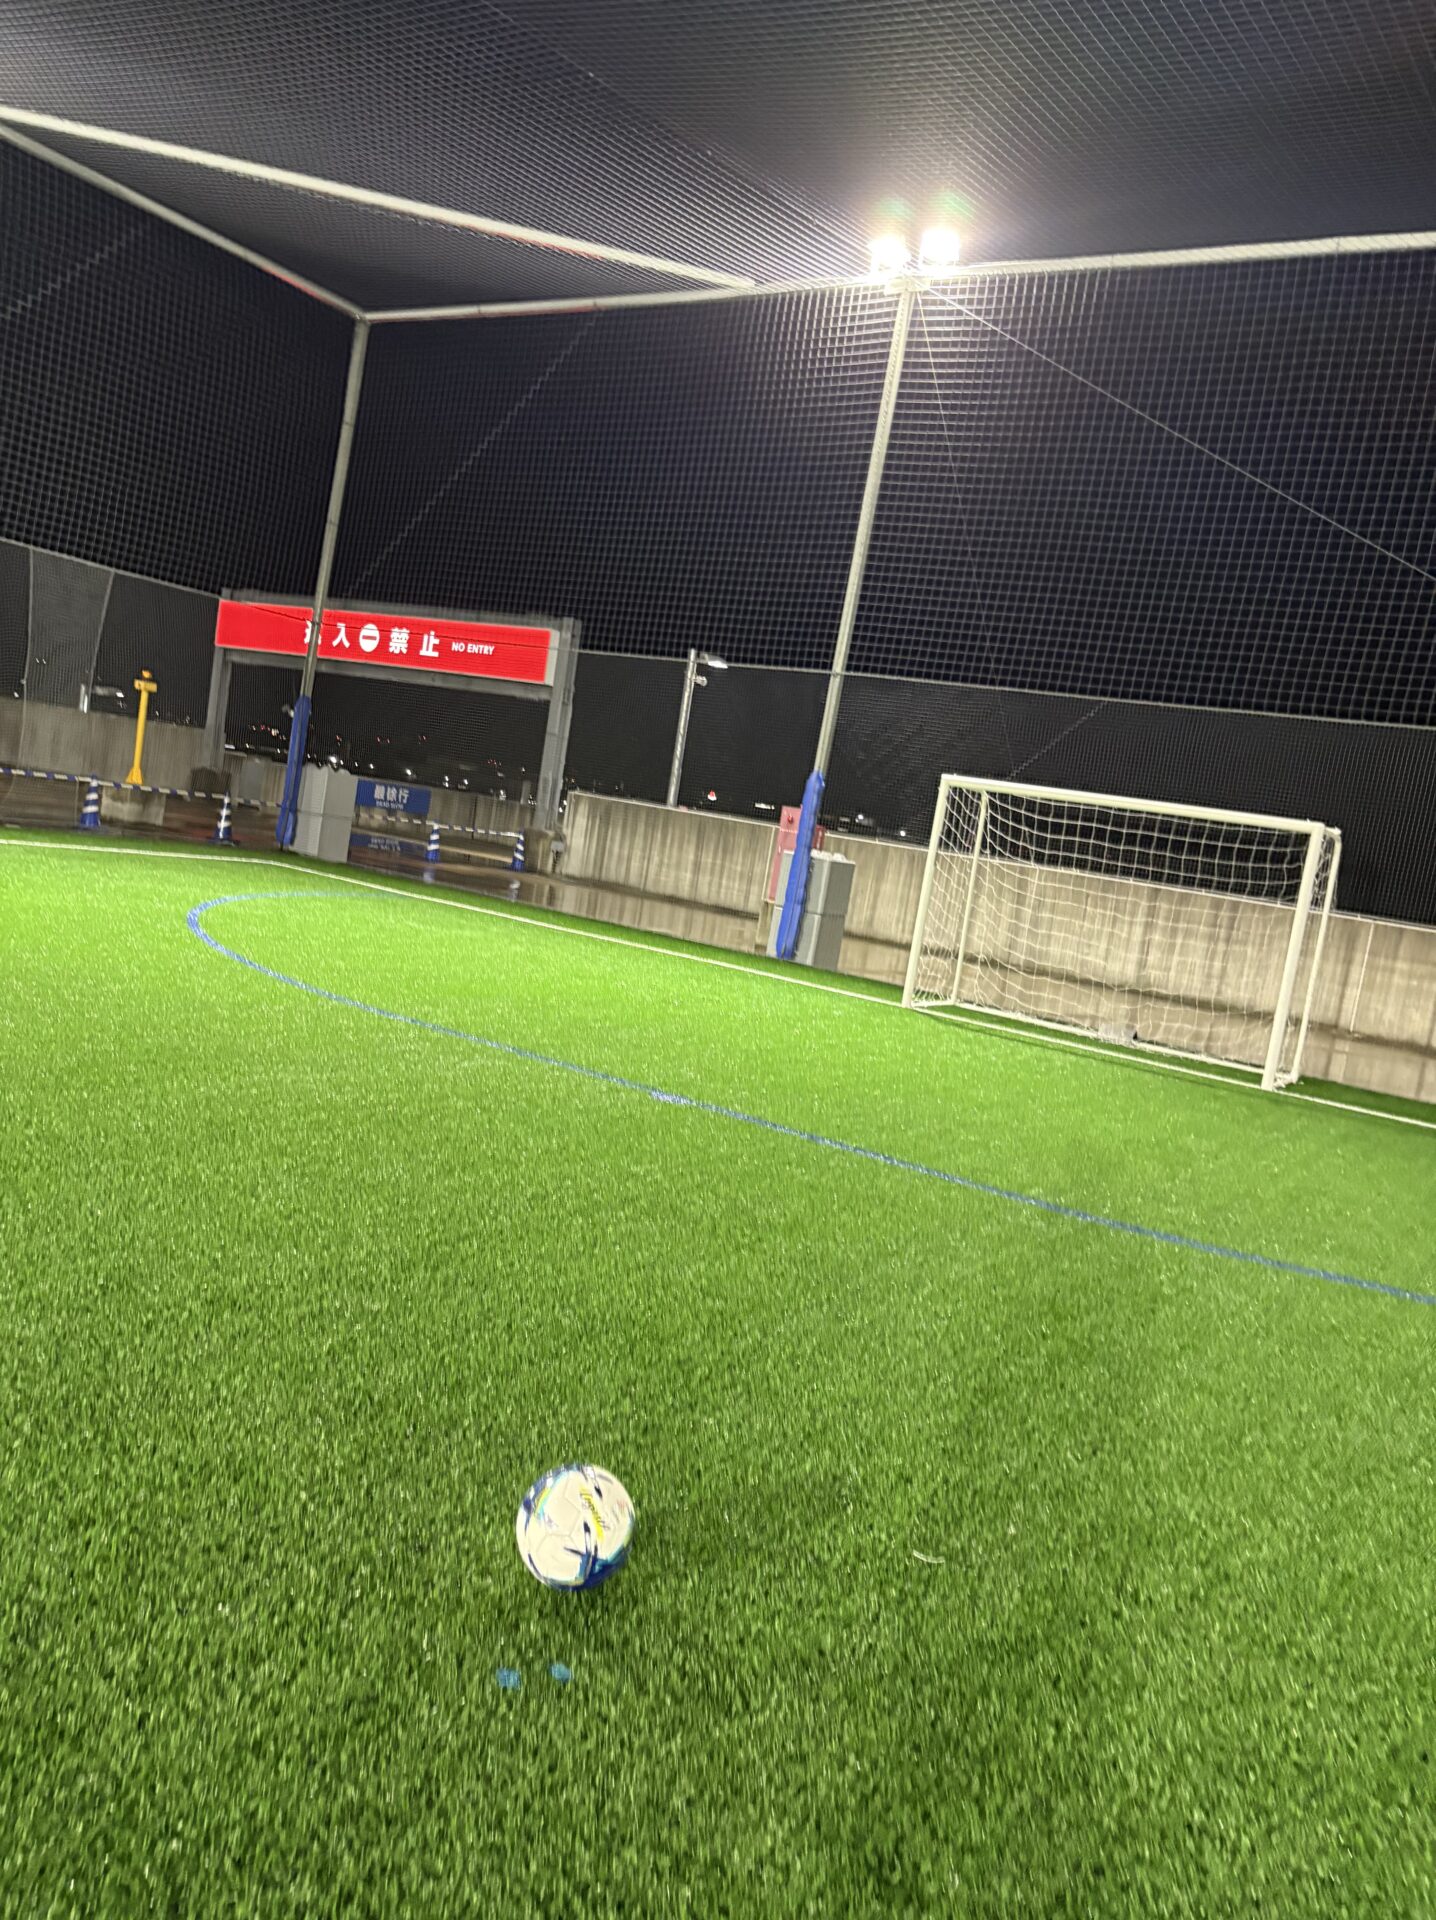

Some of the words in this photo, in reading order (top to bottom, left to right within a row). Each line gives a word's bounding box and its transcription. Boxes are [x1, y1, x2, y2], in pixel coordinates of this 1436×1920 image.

[389, 627, 440, 657] 禁止
[451, 642, 465, 652] NO
[467, 643, 494, 655] ENTRY
